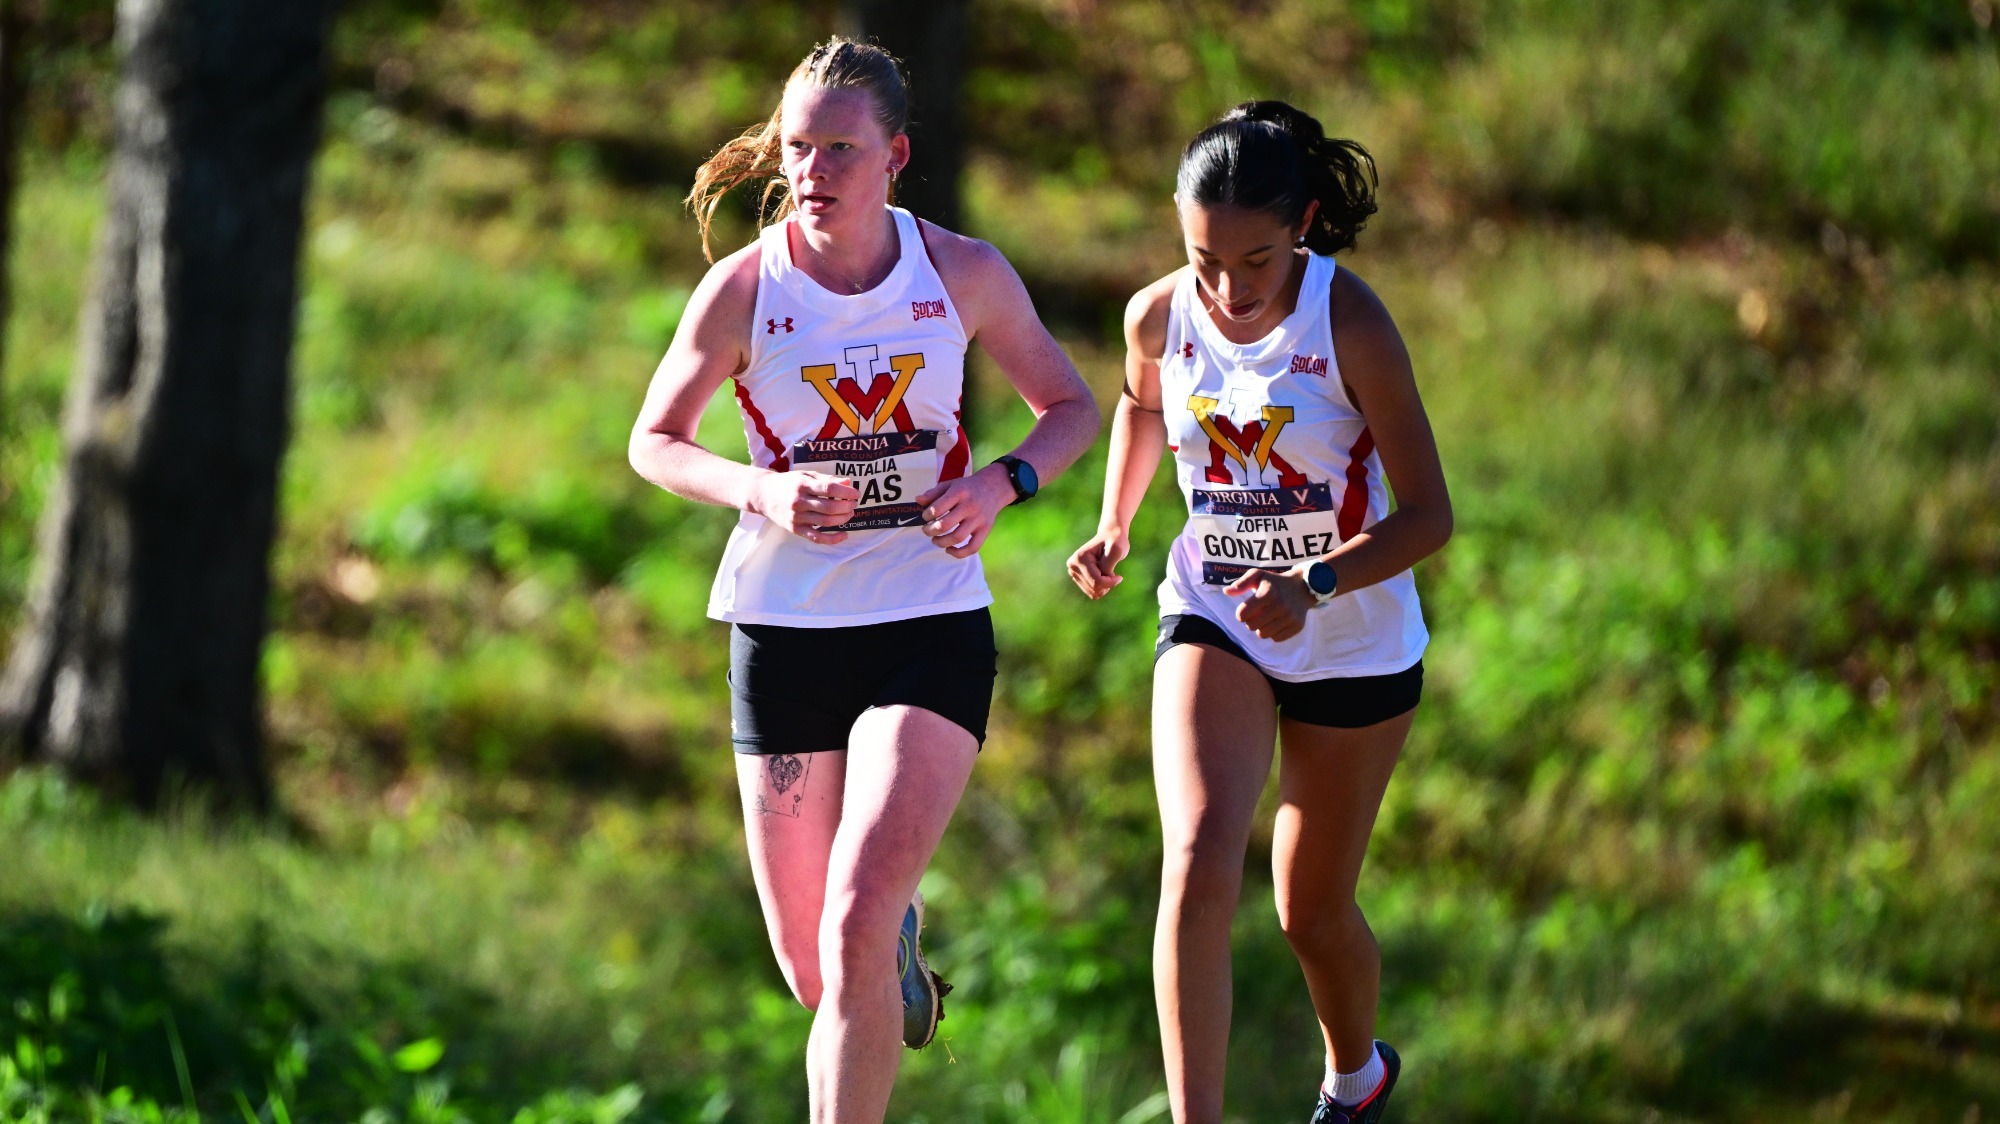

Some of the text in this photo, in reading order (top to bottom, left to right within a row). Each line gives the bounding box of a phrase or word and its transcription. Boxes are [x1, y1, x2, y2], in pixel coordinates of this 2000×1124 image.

[807, 436, 889, 452] VIRGINIA
[808, 450, 888, 461] CROSS COUNTRY
[835, 458, 897, 477] NATALIA
[1204, 491, 1280, 505] VIRGINIA
[1205, 504, 1281, 514] CROSS COUNTRY
[838, 521, 867, 529] OCTOBER
[1236, 518, 1288, 533] ZOFFIA
[1203, 532, 1334, 562] GONZALEZ
